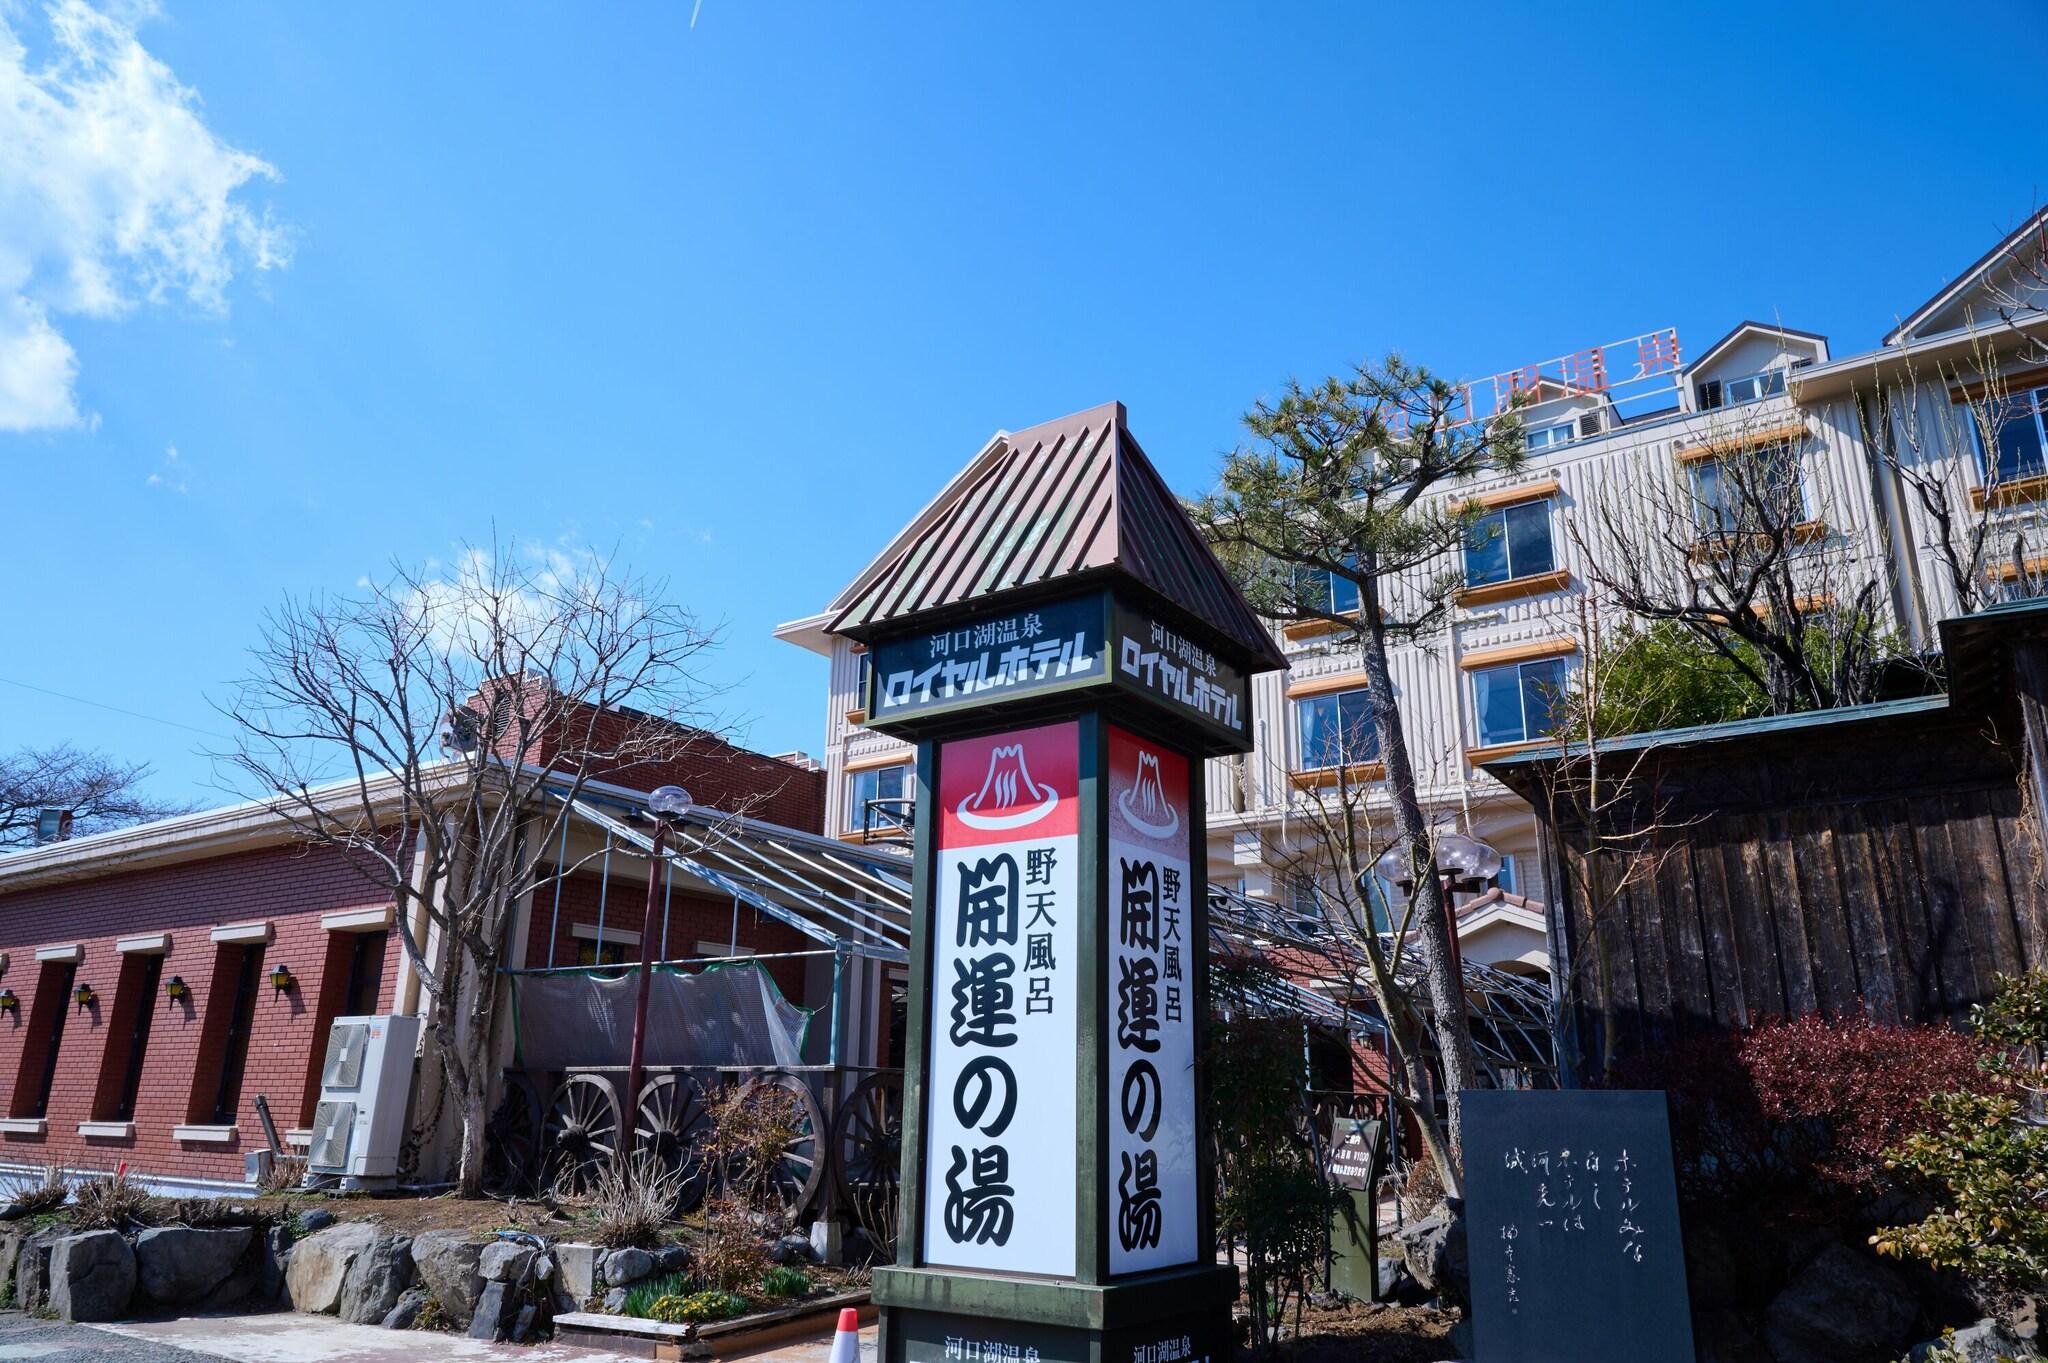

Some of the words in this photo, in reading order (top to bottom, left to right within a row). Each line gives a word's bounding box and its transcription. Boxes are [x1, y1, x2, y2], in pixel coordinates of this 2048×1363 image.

[883, 632, 1093, 709] ロイヤルホテル
[930, 613, 1044, 659] 河口湖温泉
[1150, 621, 1217, 677] 河口湖温泉
[1121, 635, 1243, 731] ロイヤルホテル
[1024, 847, 1057, 1015] 野天風呂
[1163, 865, 1182, 1023] 野天風呂
[944, 852, 1020, 1248] 開運の湯
[1118, 856, 1162, 1253] 開運の湯
[945, 1335, 1041, 1363] 河口湖温泉
[1133, 1335, 1192, 1363] 河口湖温泉
